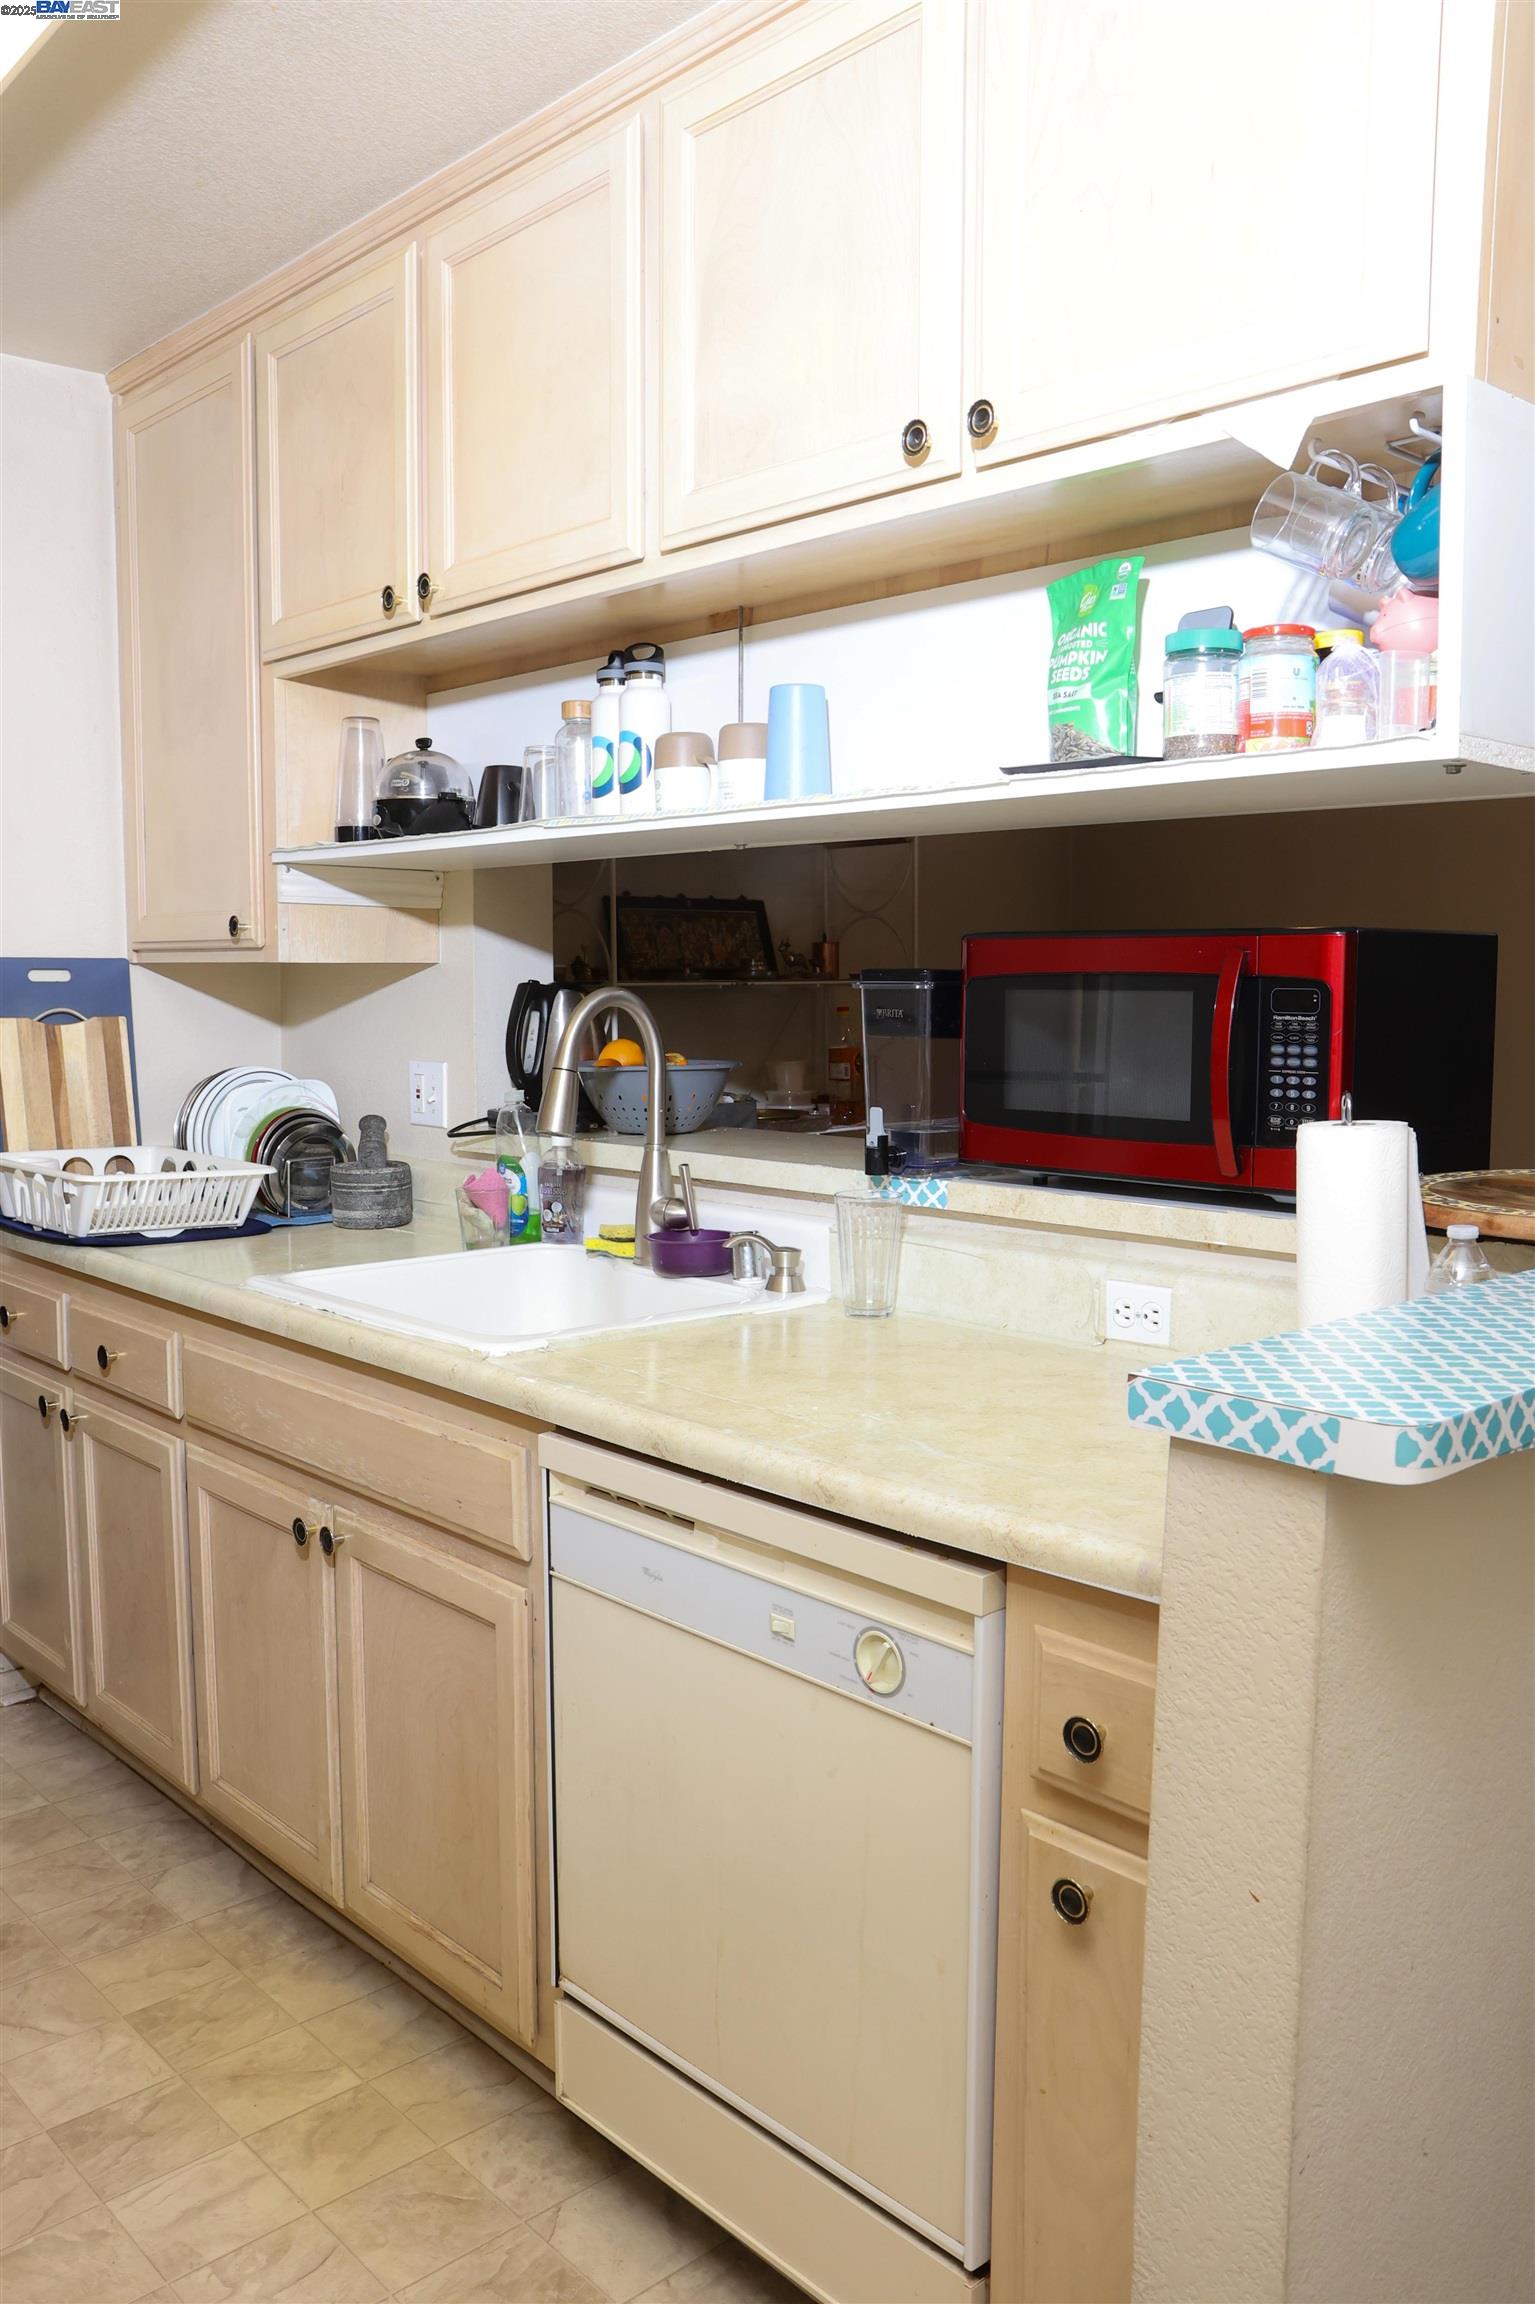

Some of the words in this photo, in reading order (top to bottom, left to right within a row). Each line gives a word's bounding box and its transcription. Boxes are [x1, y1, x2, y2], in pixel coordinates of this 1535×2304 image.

[1057, 621, 1107, 645] ORGANIC
[1049, 649, 1108, 668] PUMPKIN
[1050, 666, 1091, 684] SEEDS
